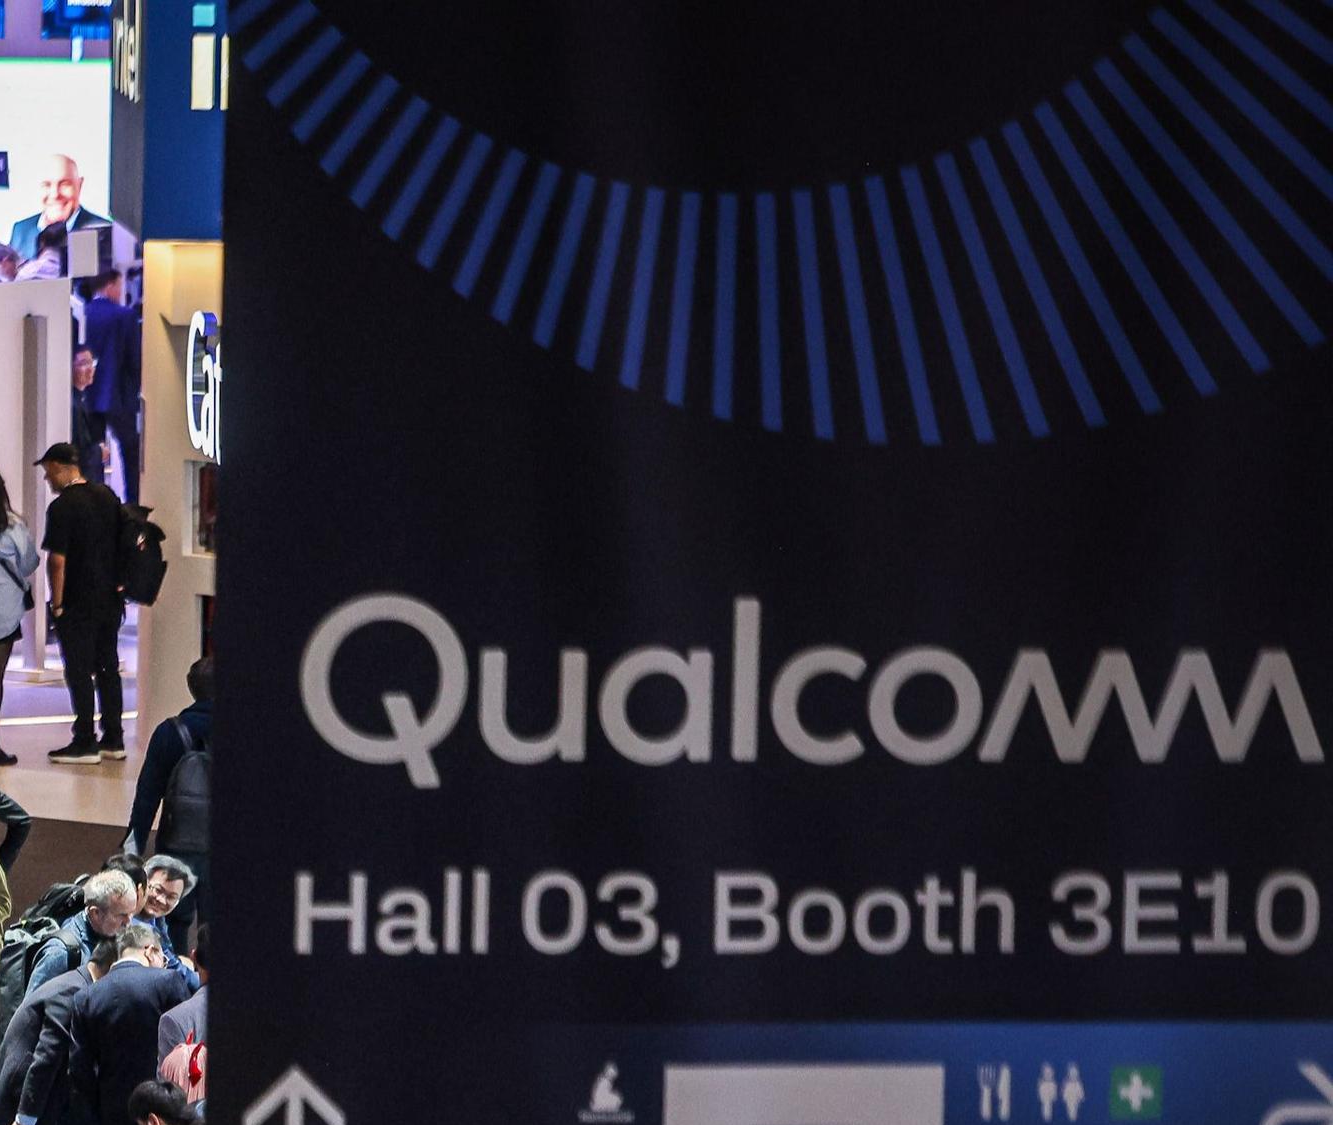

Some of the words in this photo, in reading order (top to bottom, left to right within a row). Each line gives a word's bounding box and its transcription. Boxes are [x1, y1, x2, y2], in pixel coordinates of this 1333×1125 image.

[300, 593, 1325, 790] Qualcomm
[295, 869, 490, 955] Hall
[521, 870, 680, 968] 03,
[714, 869, 1015, 955] Booth
[1050, 871, 1321, 955] 3E10
